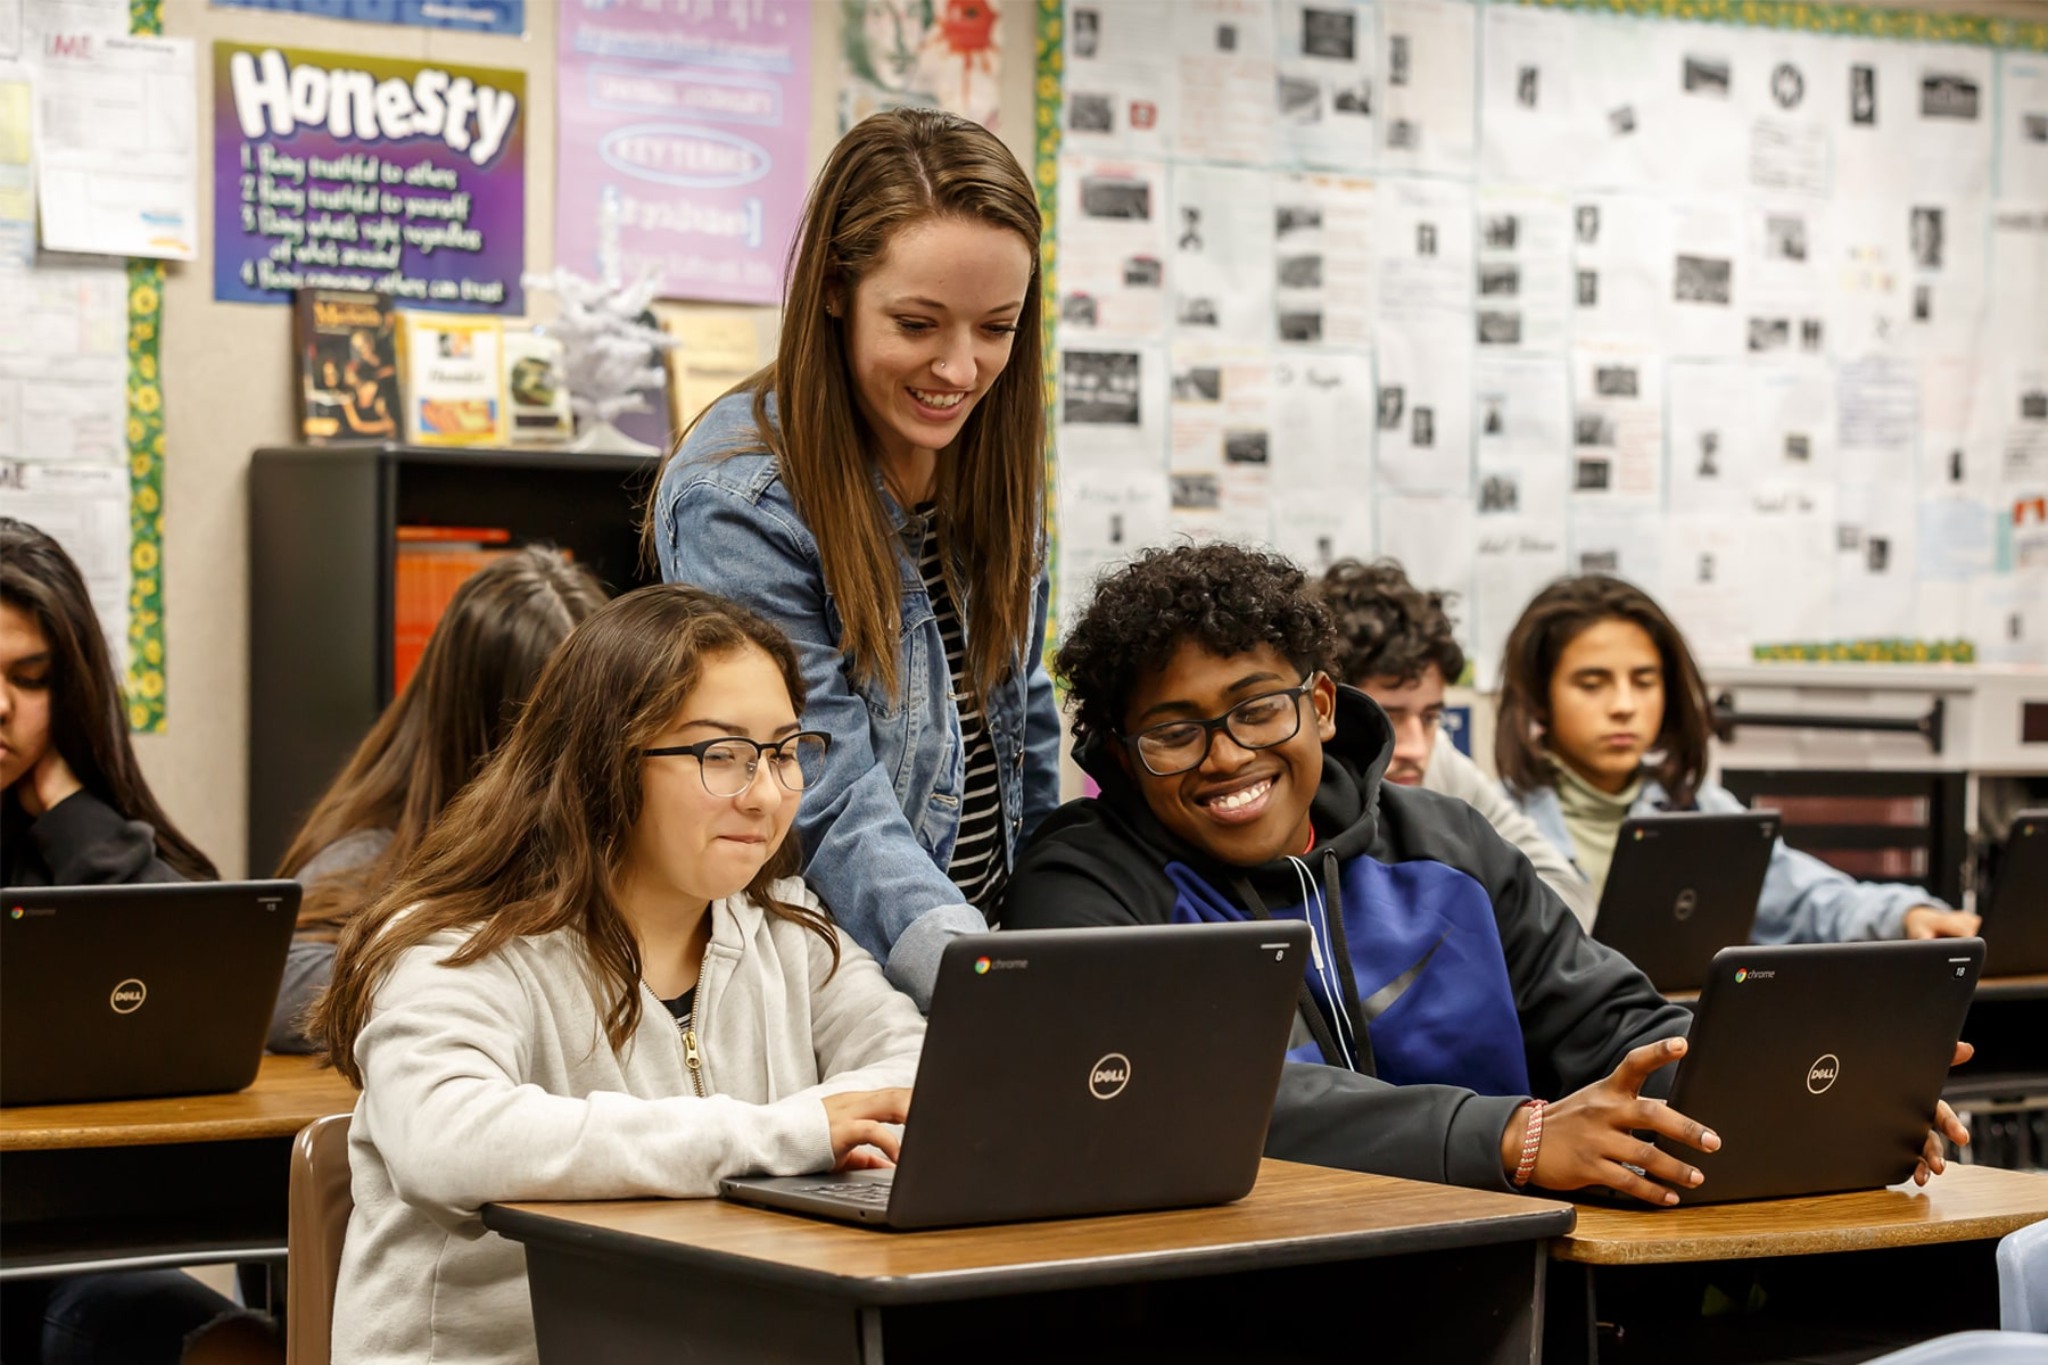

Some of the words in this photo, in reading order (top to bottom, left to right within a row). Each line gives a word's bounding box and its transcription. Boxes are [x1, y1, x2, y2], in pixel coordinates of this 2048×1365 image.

[230, 48, 516, 165] Honesty
[380, 159, 404, 184] to
[380, 190, 404, 214] to
[991, 958, 1028, 970] chrome
[1747, 969, 1776, 979] chrome
[115, 991, 141, 1002] DELL
[1094, 1069, 1125, 1083] DELL
[1811, 1068, 1834, 1080] DELL
